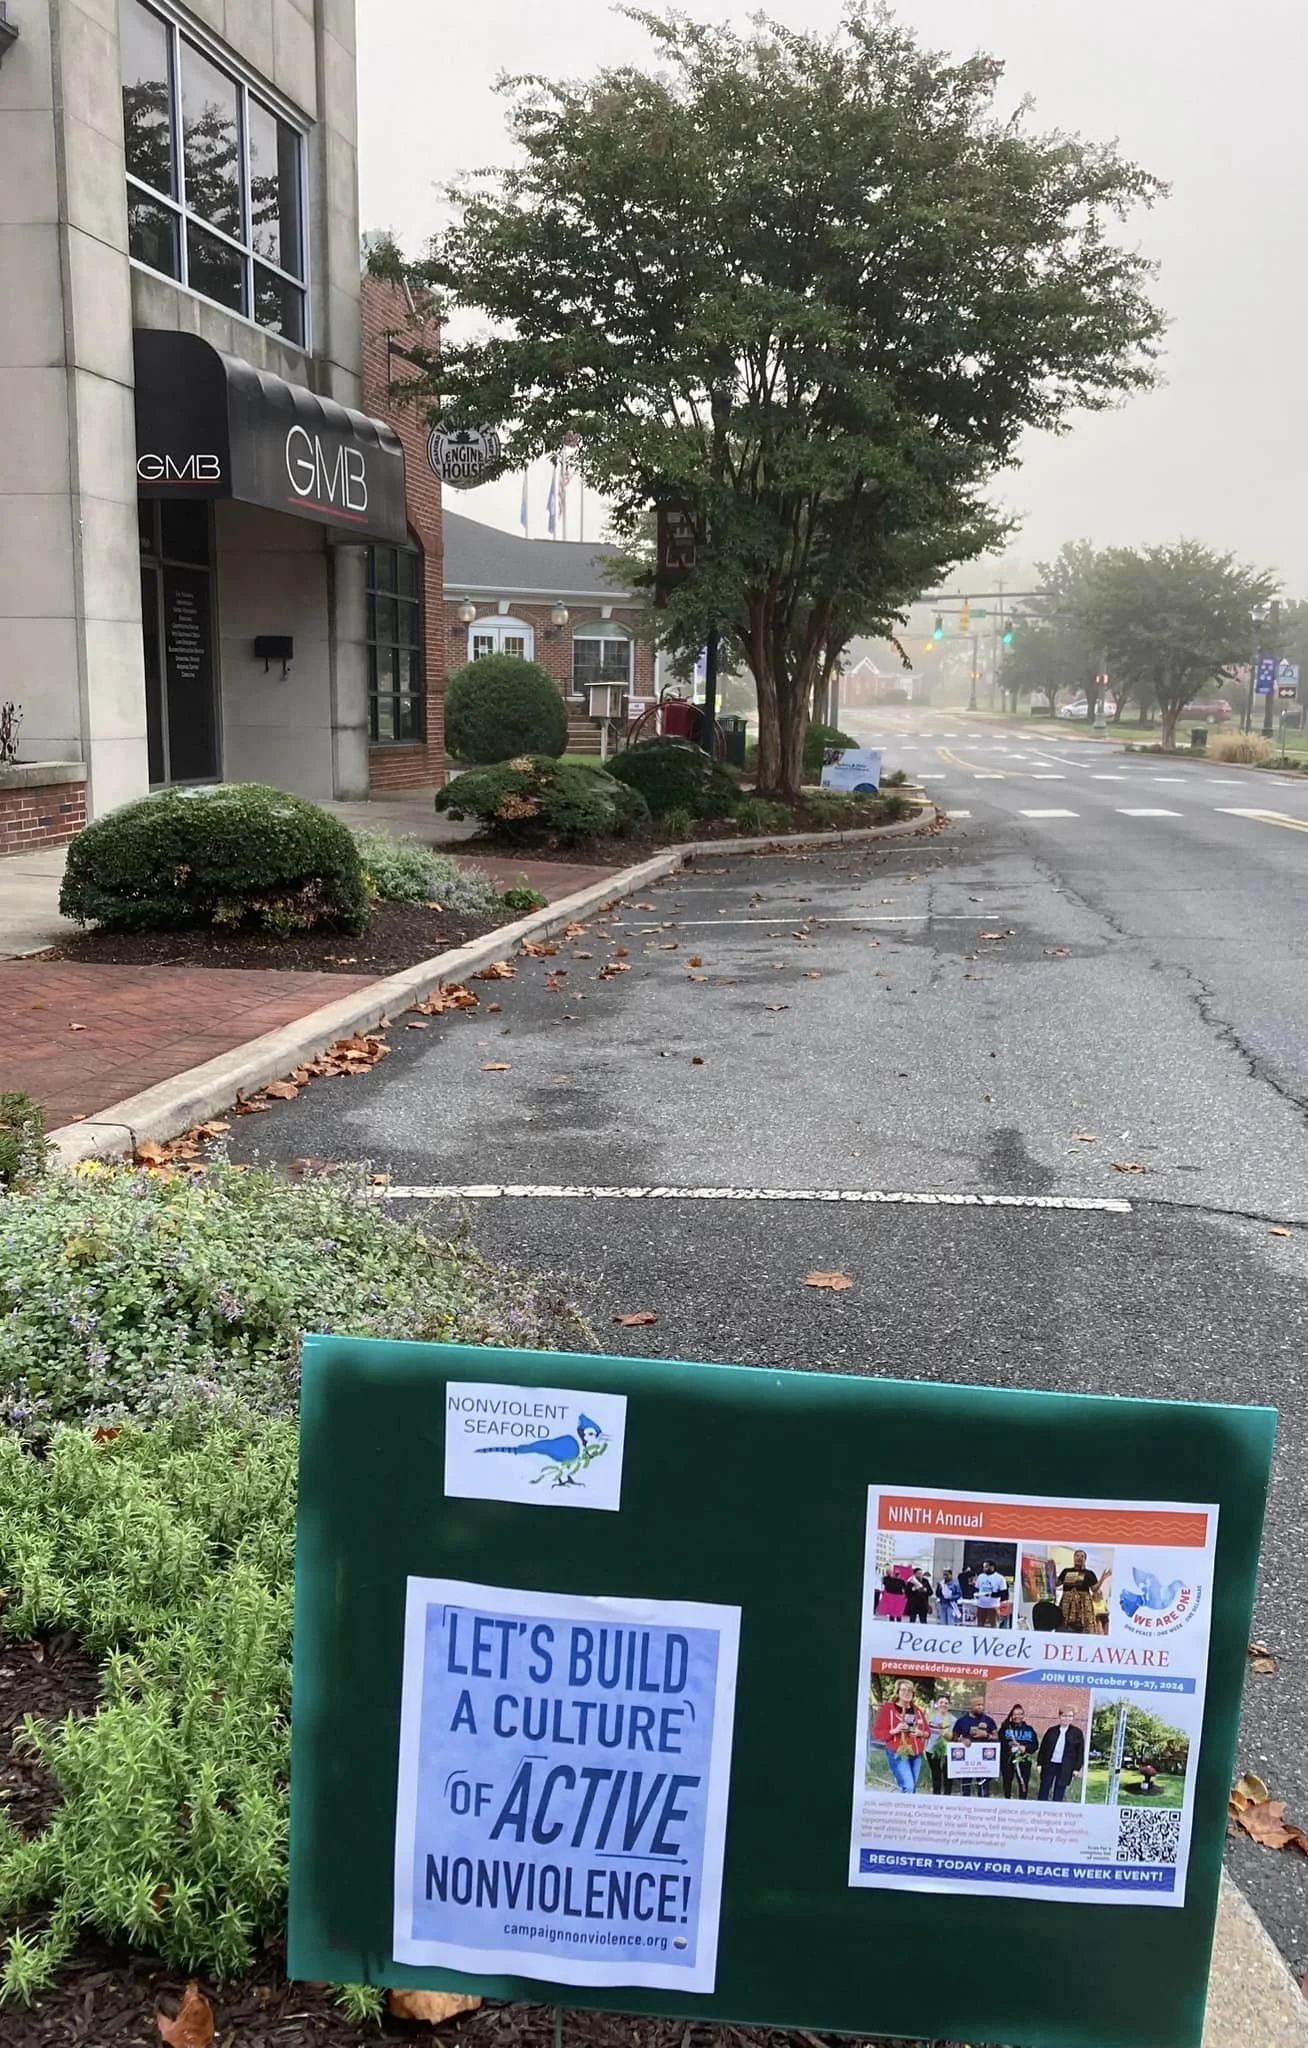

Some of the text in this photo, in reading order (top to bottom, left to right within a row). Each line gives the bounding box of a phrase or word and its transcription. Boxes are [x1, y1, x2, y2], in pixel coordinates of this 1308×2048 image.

[136, 454, 222, 480] GMB
[286, 425, 368, 512] GMB
[448, 1396, 570, 1420] NONVIOLENT
[463, 1419, 550, 1438] SEAFORD
[888, 1506, 984, 1528] NINTH Annual
[1133, 1588, 1191, 1628] WE ARE ONE
[447, 1613, 689, 1694] LET'S BUILD
[895, 1630, 1169, 1667] Peace Week DELAWARE
[881, 1661, 989, 1678] peaceweekdelaware.org
[1041, 1673, 1065, 1683] JOIN
[1068, 1674, 1084, 1684] US!
[1087, 1676, 1126, 1687] October
[1160, 1682, 1184, 1691] 2024
[449, 1690, 685, 1754] A CULTURE
[449, 1761, 701, 1855] OF ACTIVE
[869, 1854, 1163, 1882] REGISTER TODAY FOR A PEACE WEEK EVENT!
[424, 1853, 692, 1923] NONVIOLENCE!
[503, 1921, 668, 1950] campaignnonviolence.org
